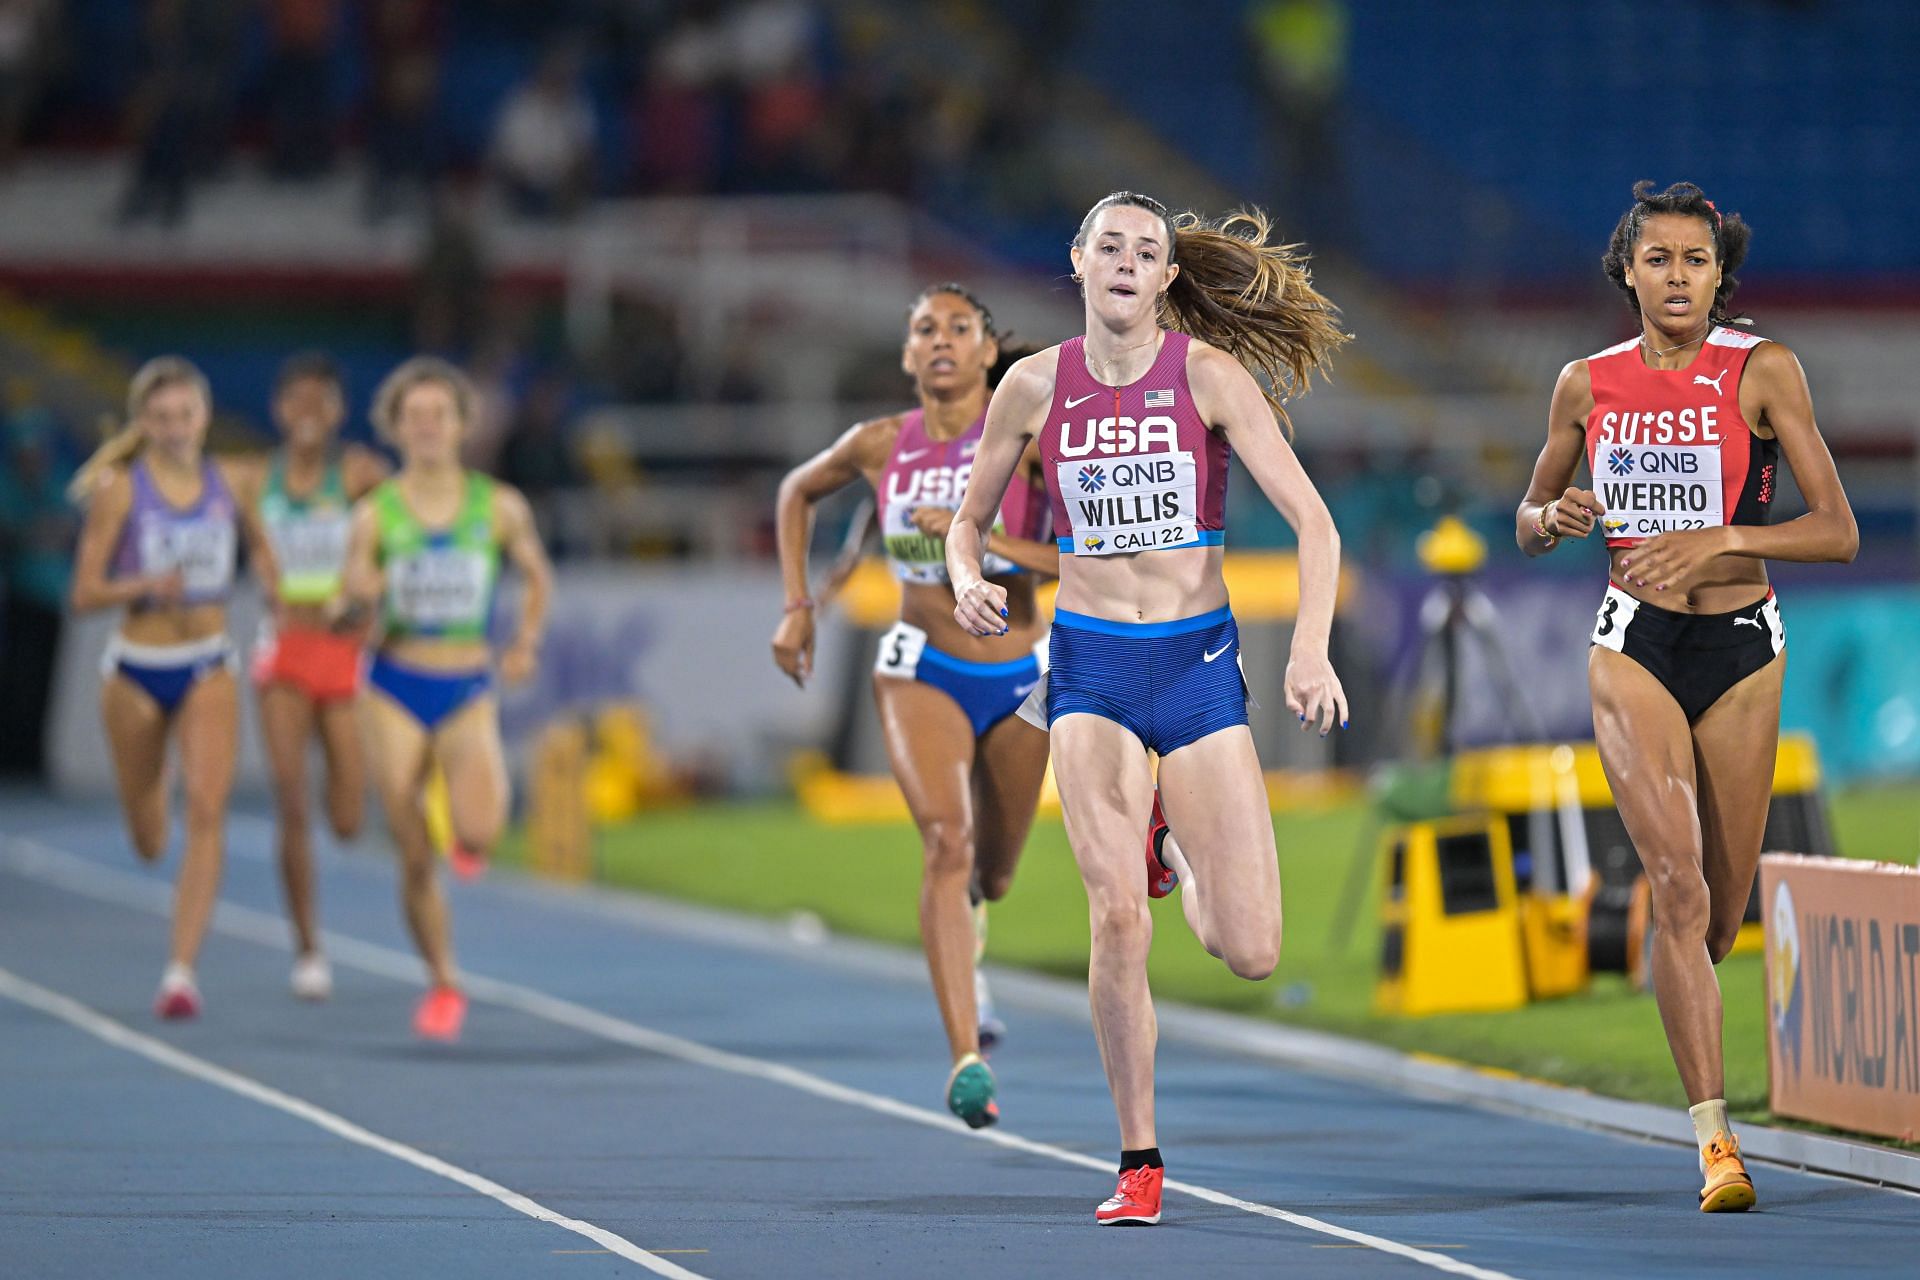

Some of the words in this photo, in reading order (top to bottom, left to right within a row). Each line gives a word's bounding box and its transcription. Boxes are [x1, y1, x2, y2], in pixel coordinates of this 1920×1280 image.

[1059, 416, 1180, 458] USA
[1112, 460, 1176, 487] QNB
[1640, 451, 1699, 474] QNB
[1078, 491, 1180, 527] WILLIS
[1603, 482, 1707, 512] WERRO
[1113, 530, 1157, 549] CALI
[1161, 526, 1184, 544] 22
[1597, 596, 1619, 637] 3
[886, 633, 906, 667] 5
[1805, 914, 1888, 1088] WORLD
